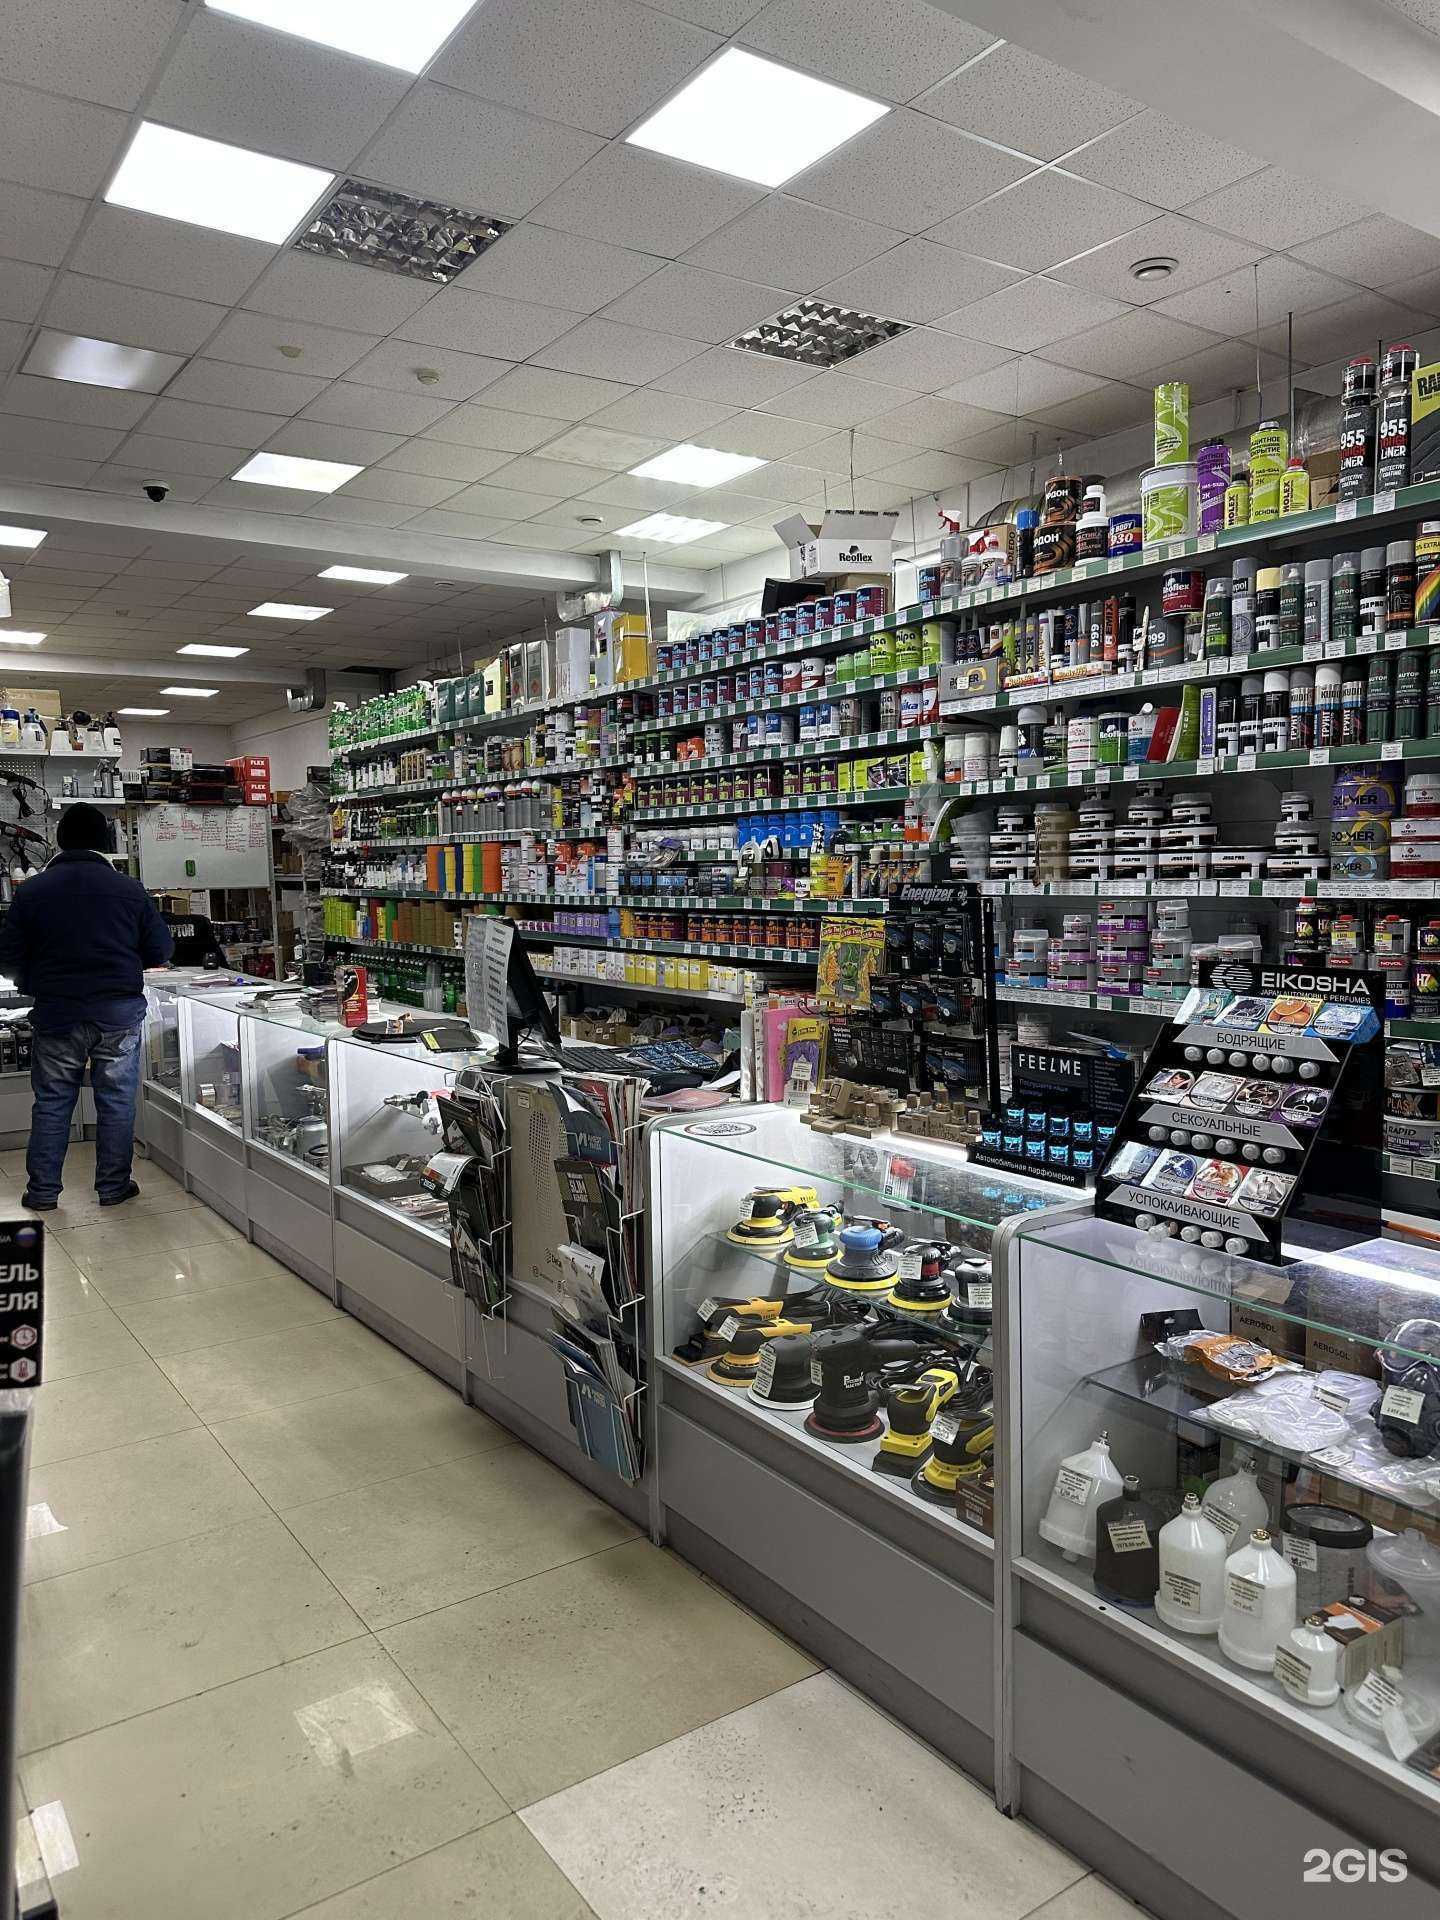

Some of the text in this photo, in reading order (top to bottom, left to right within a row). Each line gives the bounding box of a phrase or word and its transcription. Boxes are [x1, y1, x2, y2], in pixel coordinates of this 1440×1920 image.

[1380, 418, 1408, 438] 955
[1340, 429, 1365, 449] 955
[1381, 446, 1406, 459] LINER
[1340, 455, 1364, 470] LINER
[1046, 489, 1069, 500] РДОН
[1008, 531, 1016, 564] OLEDO
[1110, 532, 1134, 545] 930
[839, 552, 872, 563] Reoflex
[1290, 713, 1298, 740] ГРУНТ
[1321, 709, 1329, 738] ГРУНТ
[1343, 709, 1351, 736] ГРУНТ
[900, 884, 954, 905] Energizer
[168, 924, 195, 938] PTOR
[1296, 921, 1307, 933] H7
[1330, 957, 1352, 966] NOVOL
[1380, 959, 1403, 968] NOVOL
[1261, 972, 1370, 995] EIKOSHA
[1416, 973, 1430, 987] H7
[1260, 989, 1371, 1005] JAPAN AUTOMOBILE PERFUMES
[1216, 1032, 1287, 1051] БОДРЯЩИЕ
[1172, 1111, 1262, 1138] СЕКСУАЛЬНЫЕ
[1388, 1126, 1417, 1136] RAPID
[975, 1152, 1075, 1184] Автомобильная парфюмерия
[1128, 1190, 1240, 1229] УСПОКАИВАЮЩИЕ
[1239, 1316, 1277, 1333] AEROSOL
[1313, 1340, 1351, 1360] AEROSOL
